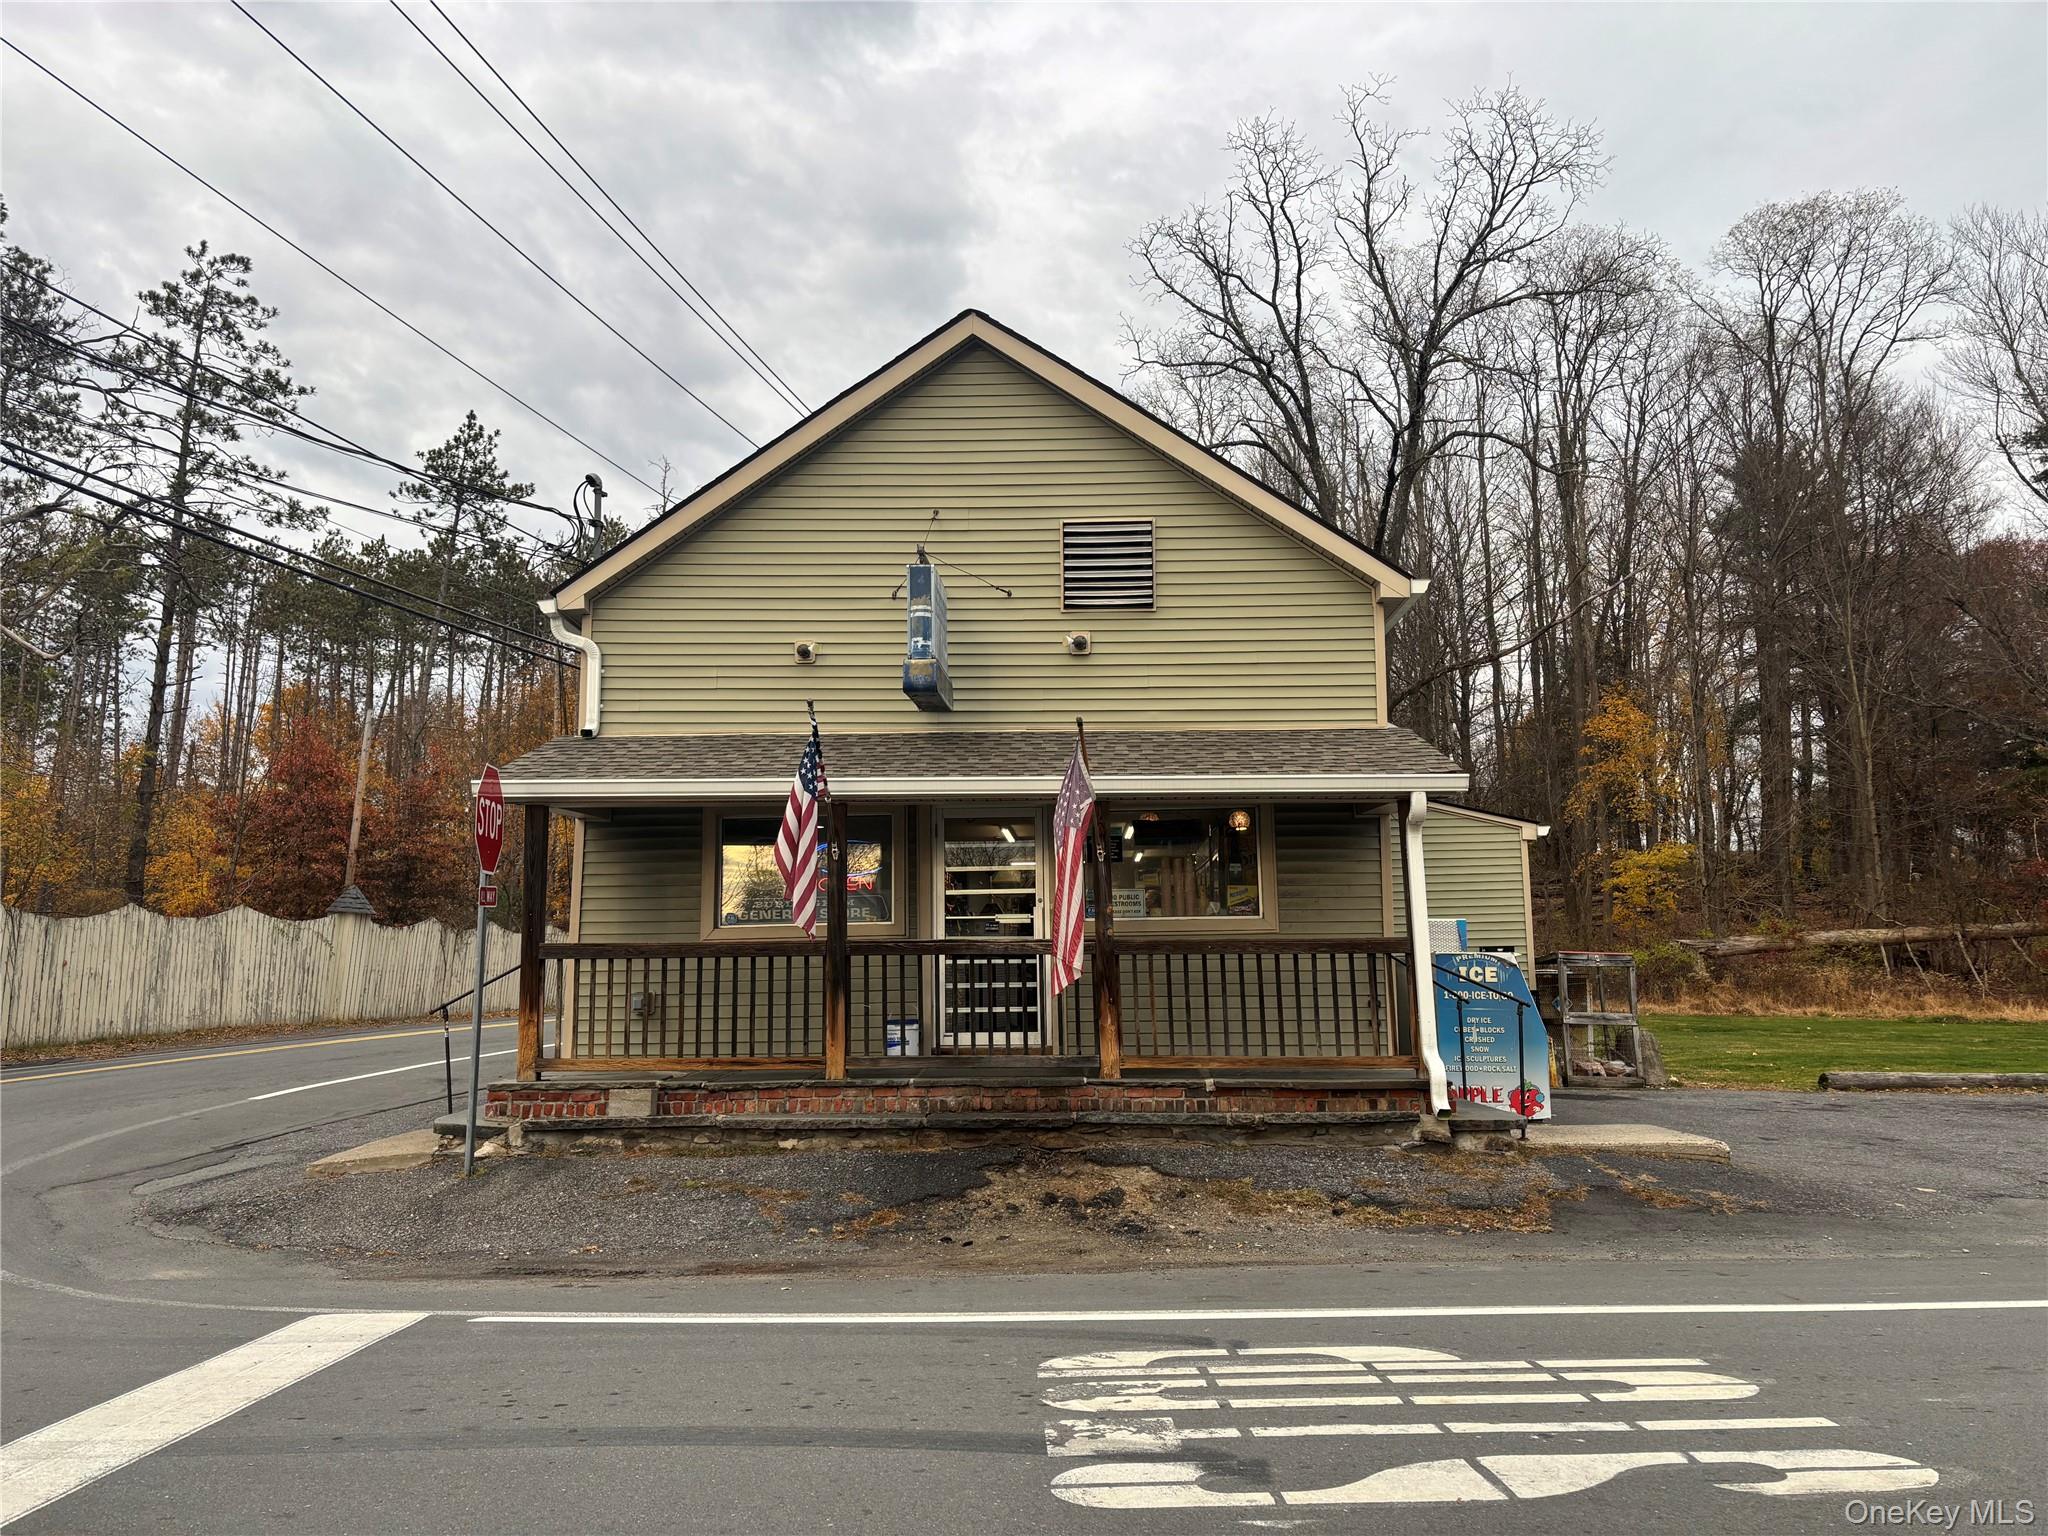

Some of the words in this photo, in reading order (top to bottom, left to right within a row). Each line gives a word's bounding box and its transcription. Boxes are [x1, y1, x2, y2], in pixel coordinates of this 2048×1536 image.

[478, 796, 502, 840] STOP
[818, 875, 873, 891] OEN
[739, 908, 793, 920] GENER
[819, 908, 870, 918] SRE
[1455, 954, 1498, 963] PREMIUM
[1458, 967, 1498, 983] ICE
[1466, 1016, 1479, 1024] DRY
[1480, 1016, 1492, 1024] ICE
[1465, 1055, 1507, 1063] SCULPTURES
[1037, 1346, 1940, 1509] STOP
